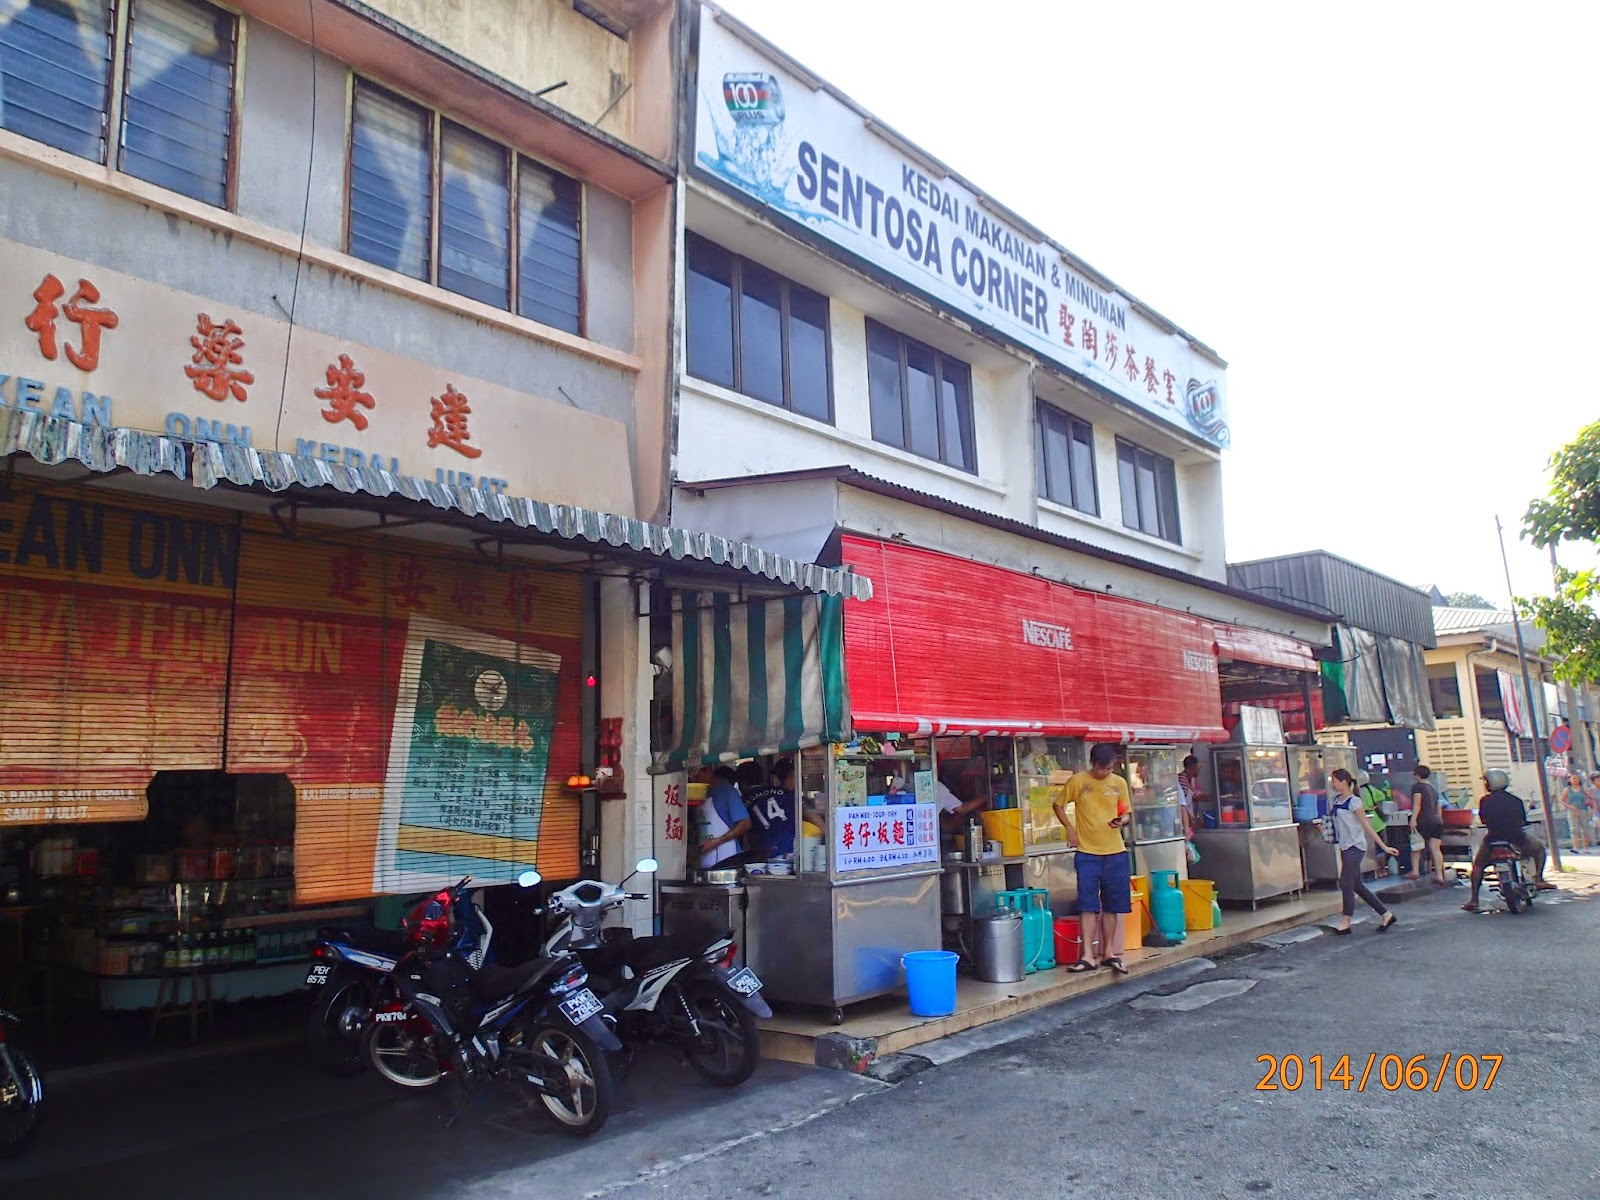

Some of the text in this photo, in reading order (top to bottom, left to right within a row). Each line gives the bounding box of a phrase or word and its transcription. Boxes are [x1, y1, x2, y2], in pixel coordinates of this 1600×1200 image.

[729, 83, 758, 109] 100
[737, 111, 765, 119] PLUS
[797, 141, 1049, 335] SENTOSA CORNER
[902, 163, 1126, 332] KEDAI MAKANAN & MINUMAN
[10, 790, 53, 802] BADAN
[58, 790, 93, 801] SAKIT
[4, 807, 40, 821] SAKIT
[752, 796, 788, 829] 14
